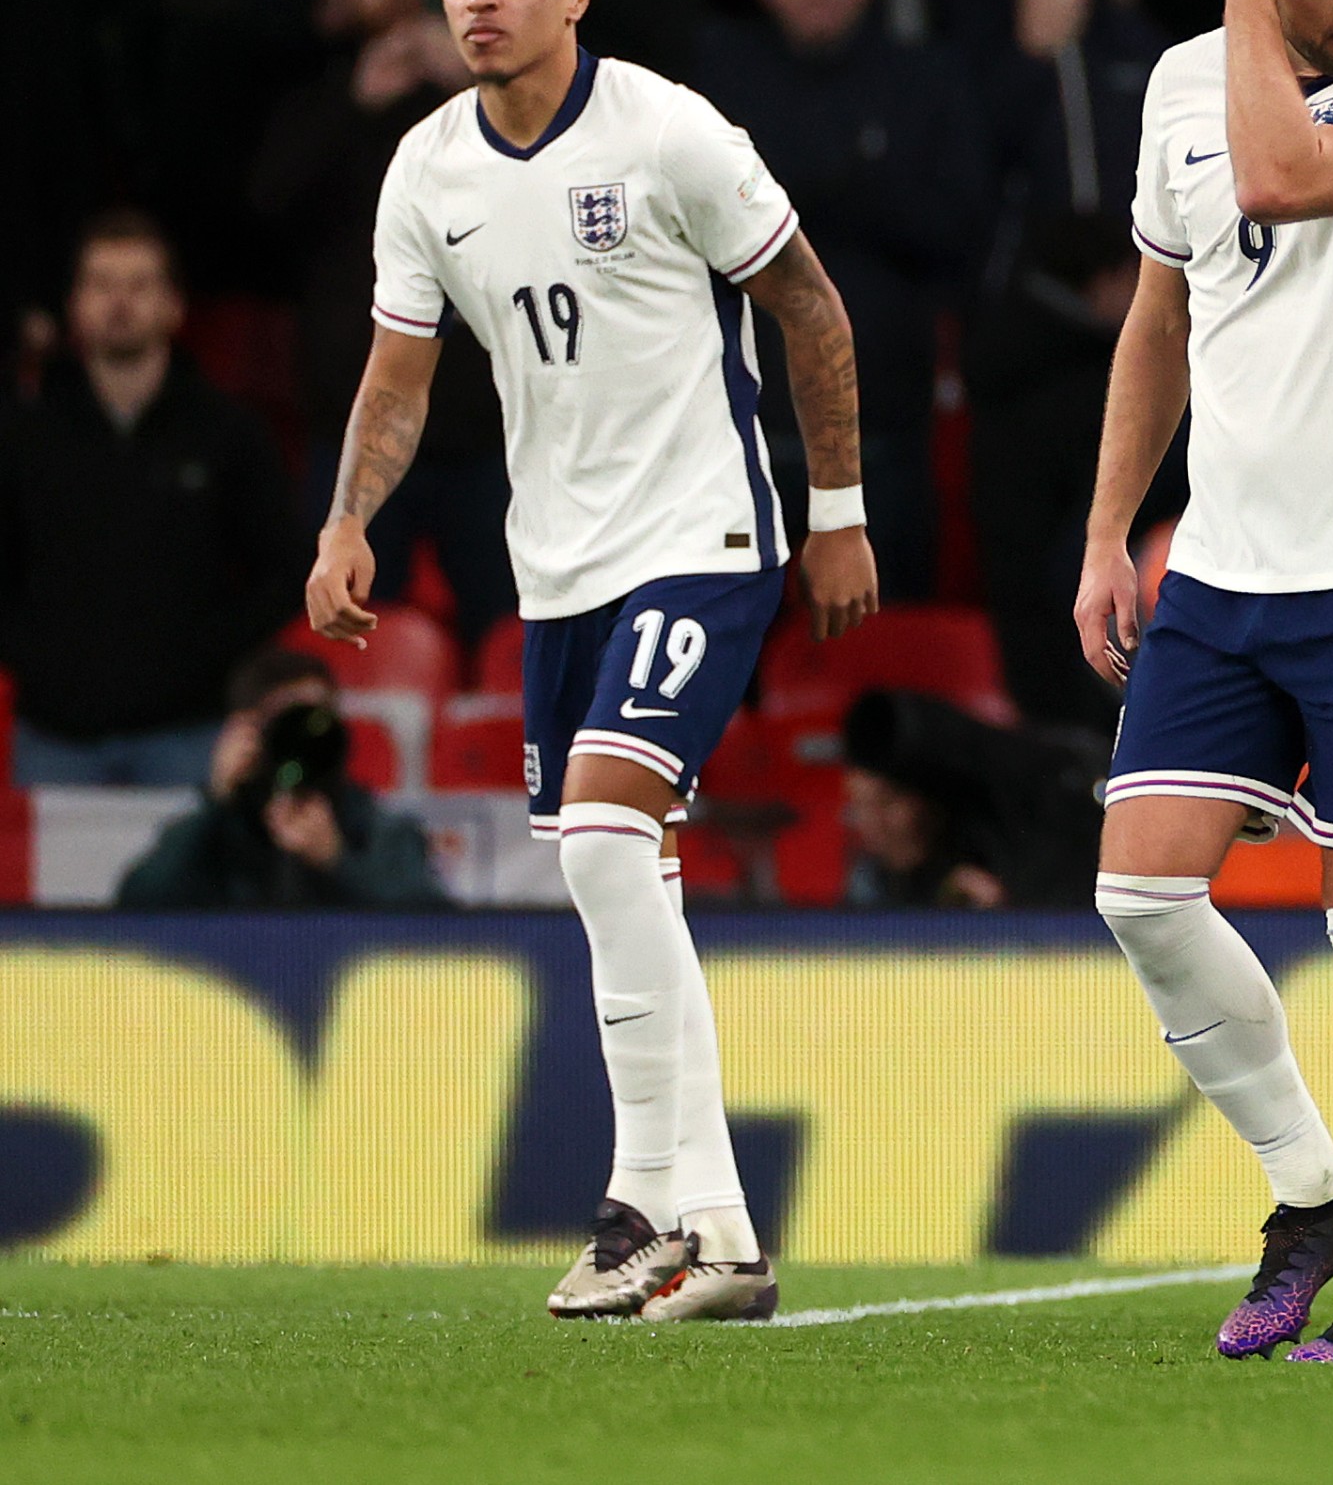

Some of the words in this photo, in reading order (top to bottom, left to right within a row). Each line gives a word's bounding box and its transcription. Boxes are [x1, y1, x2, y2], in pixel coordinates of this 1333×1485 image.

[1237, 216, 1278, 292] 9
[513, 283, 582, 365] 19
[629, 608, 706, 698] 19
